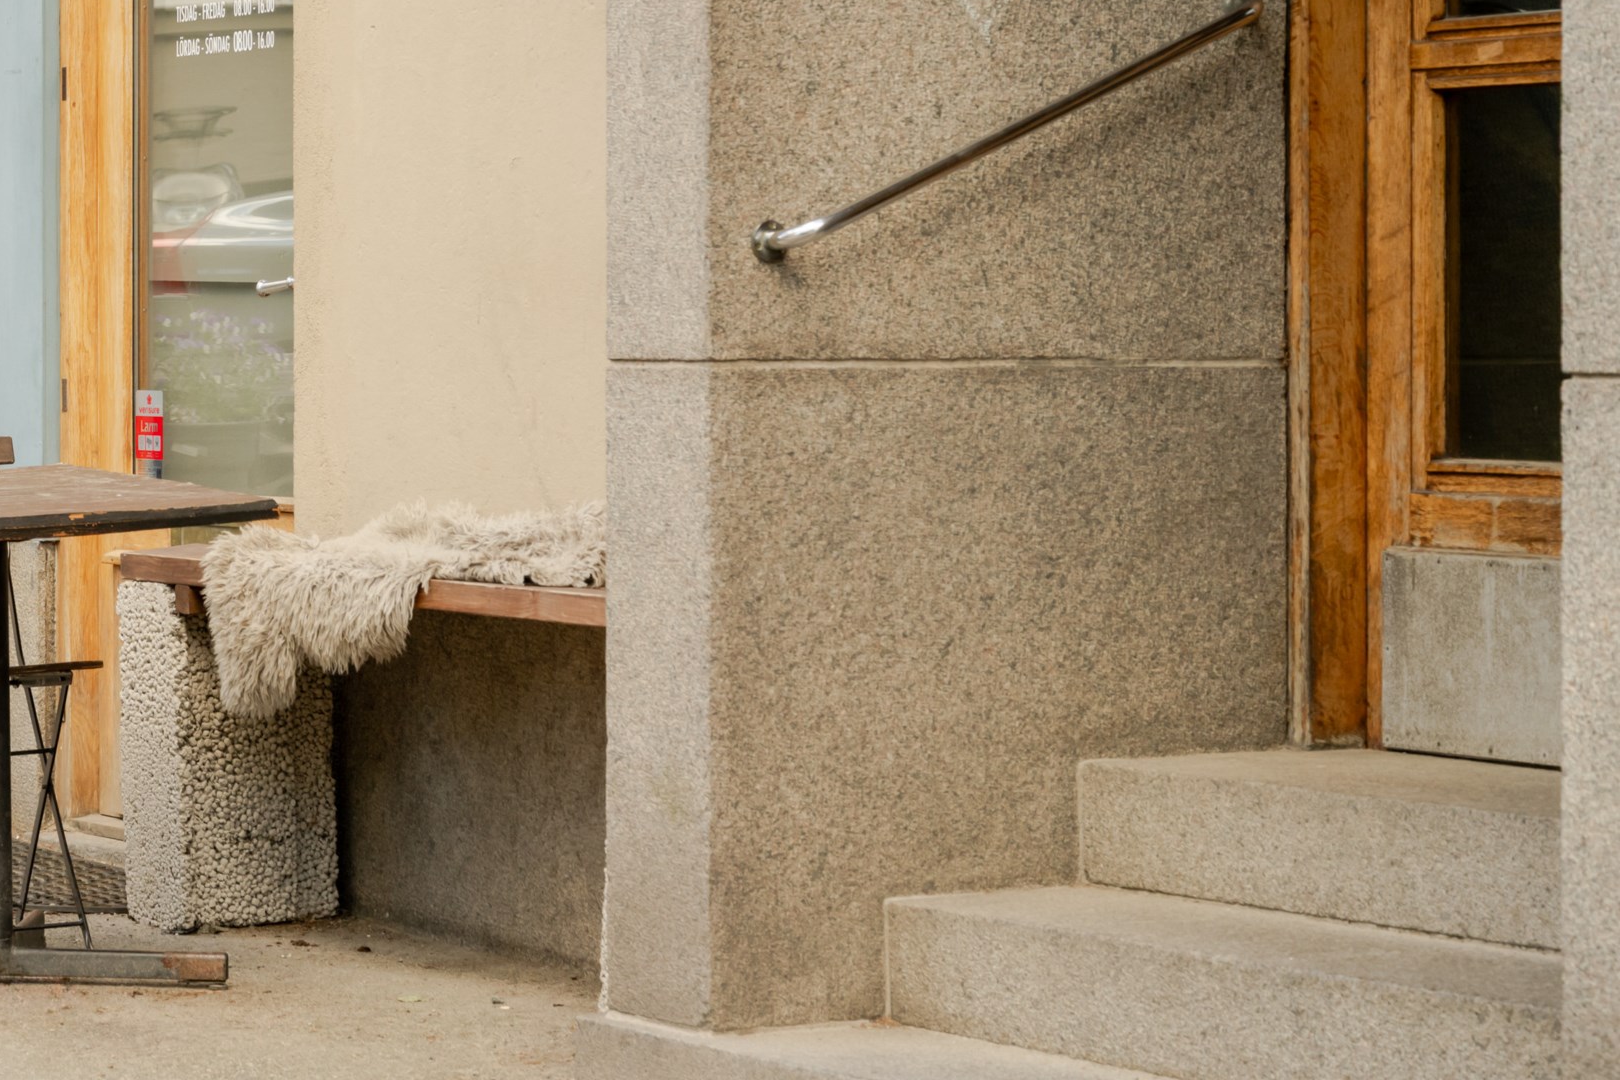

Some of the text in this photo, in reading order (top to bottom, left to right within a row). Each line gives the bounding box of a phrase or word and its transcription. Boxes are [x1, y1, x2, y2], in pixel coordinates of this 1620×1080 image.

[176, 2, 198, 23] TISDAG
[202, 1, 226, 20] FREDAG
[176, 37, 200, 57] LÖRDAG
[205, 33, 230, 55] SÖNDAG
[257, 31, 275, 50] 16.00
[140, 420, 159, 432] Larm
